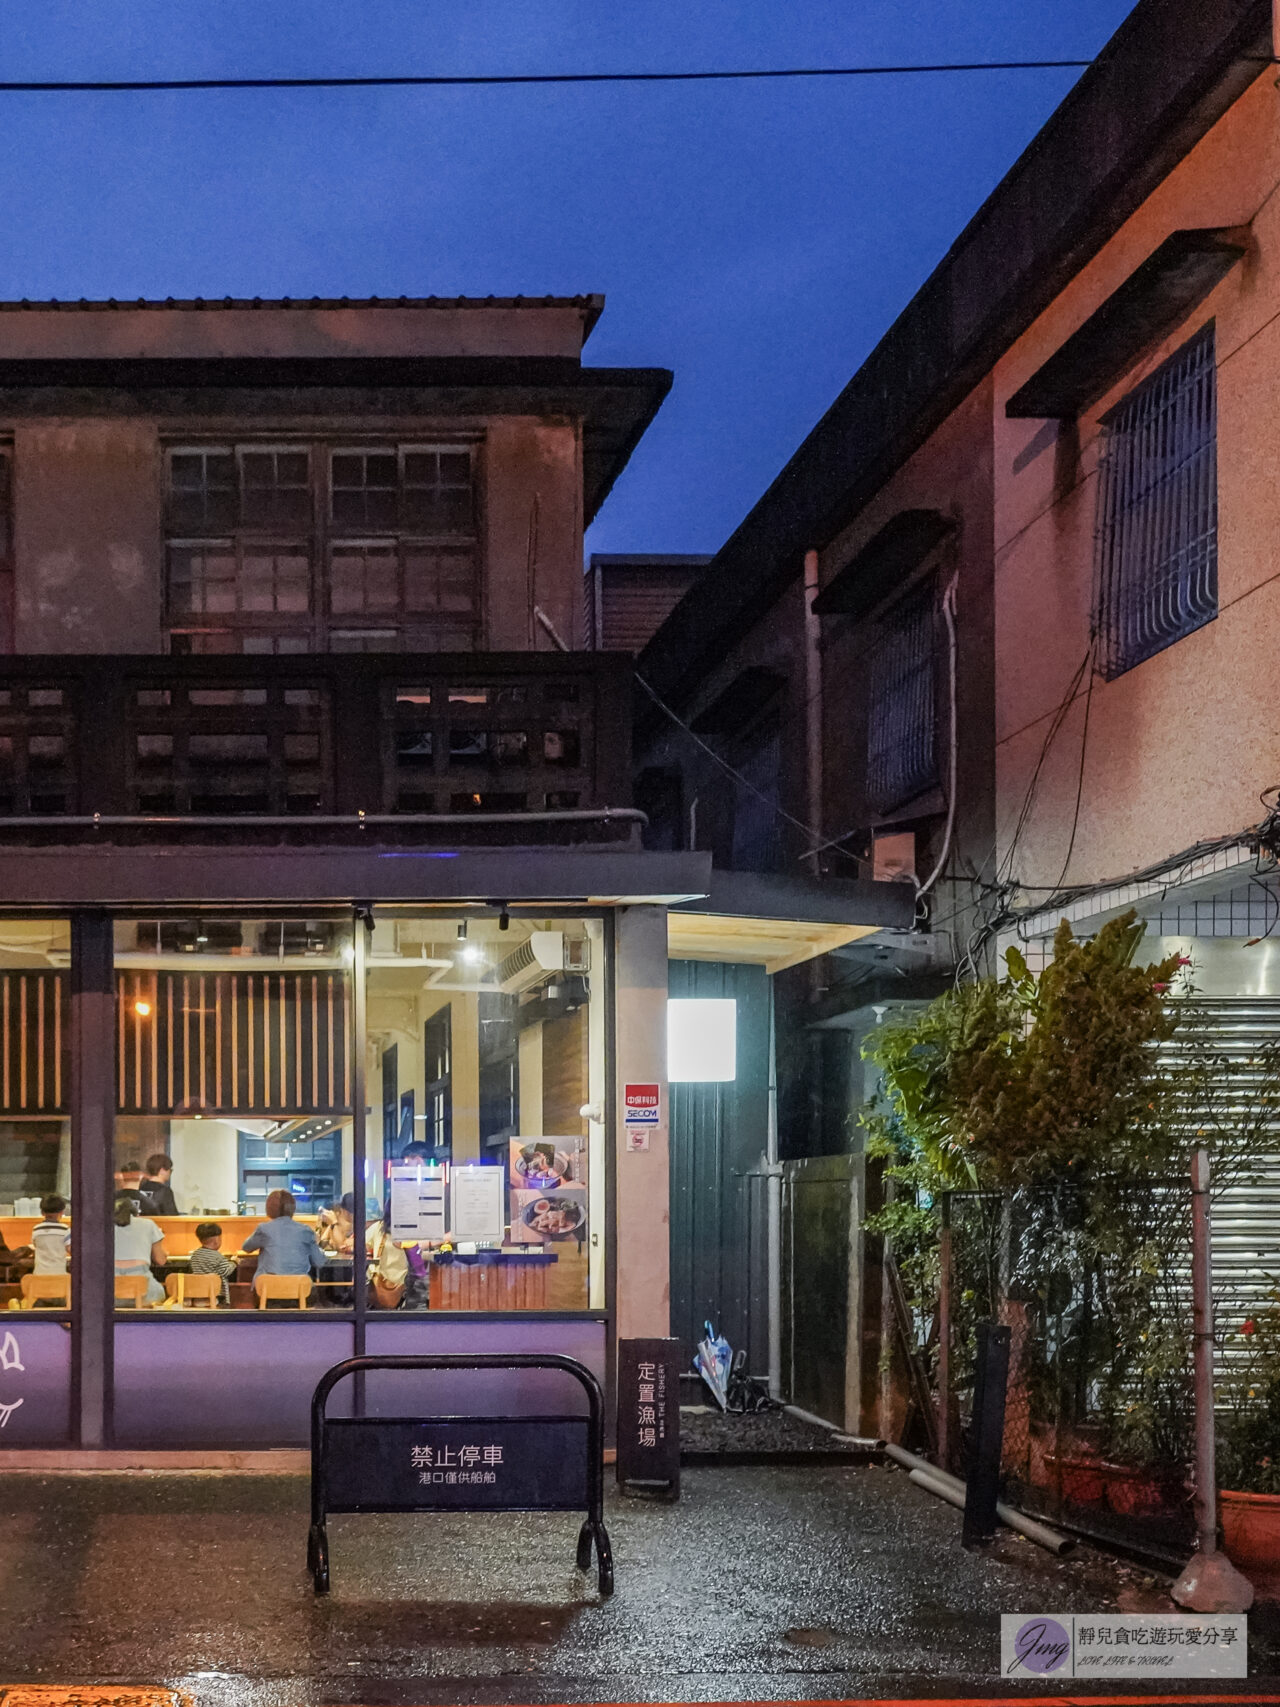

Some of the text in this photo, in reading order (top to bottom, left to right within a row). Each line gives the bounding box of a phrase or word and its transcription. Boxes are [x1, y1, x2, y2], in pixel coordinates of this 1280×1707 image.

[627, 1109, 657, 1118] SECOM
[658, 1363, 666, 1398] FISHERY
[637, 1361, 656, 1447] 定置漁場
[658, 1401, 666, 1417] THE
[411, 1445, 504, 1467] 禁止停車
[419, 1471, 496, 1484] 港口僅供船舶
